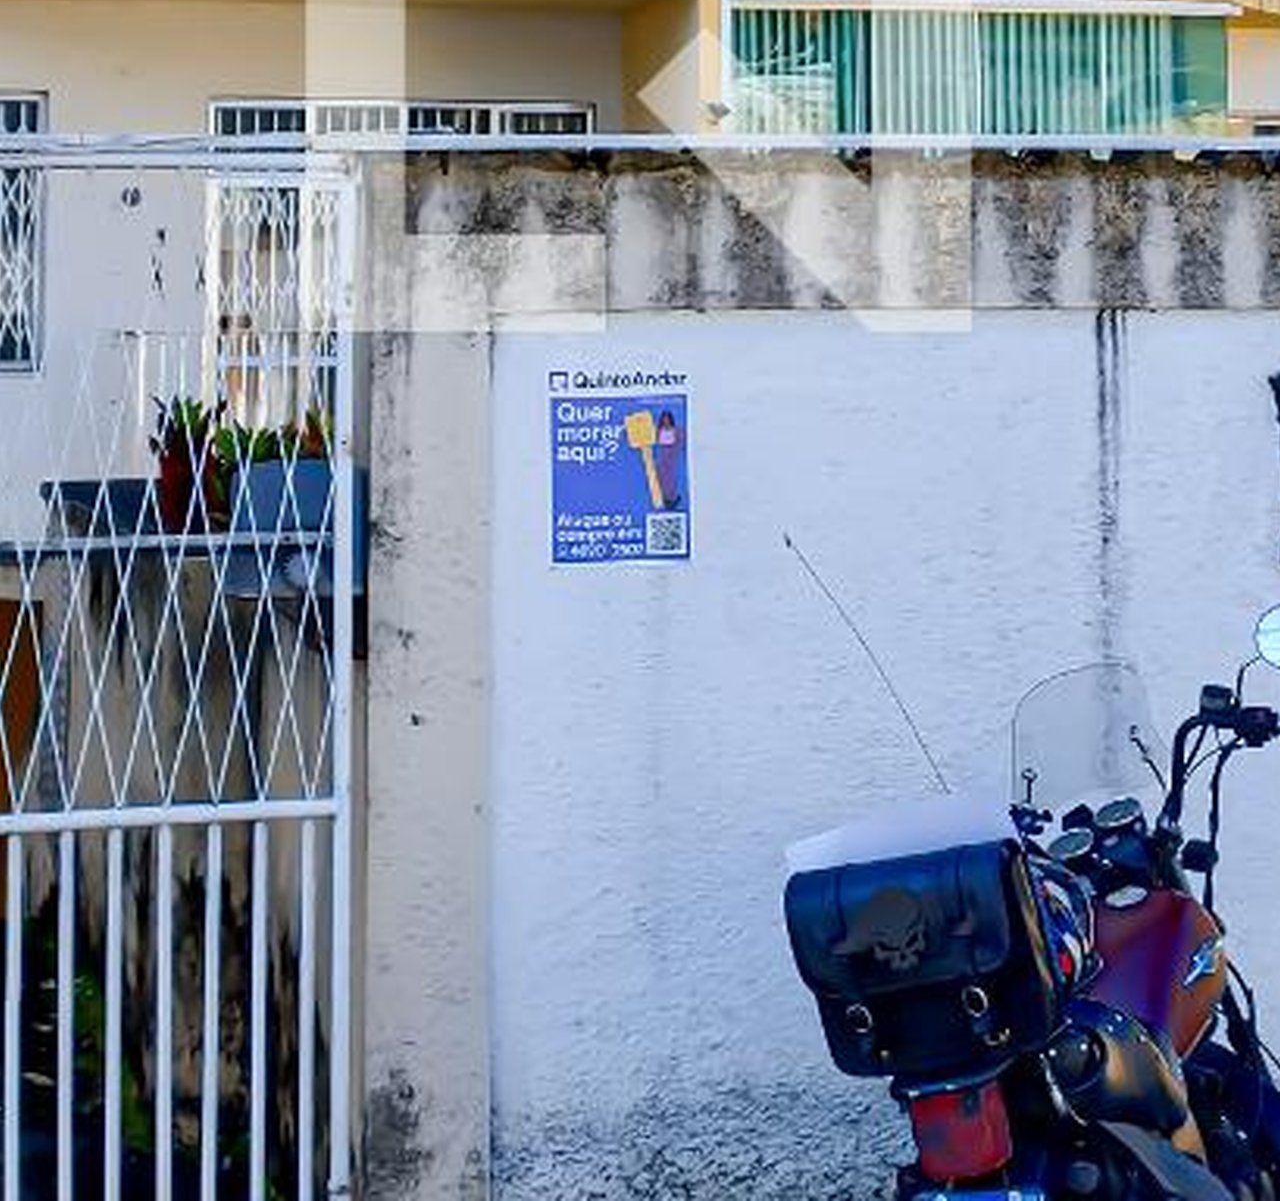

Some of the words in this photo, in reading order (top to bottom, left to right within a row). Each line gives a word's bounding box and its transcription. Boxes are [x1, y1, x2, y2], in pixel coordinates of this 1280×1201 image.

[573, 370, 687, 389] QuintoAndar
[557, 403, 612, 423] Quer
[557, 425, 622, 442] morar
[557, 441, 619, 466] aqui?
